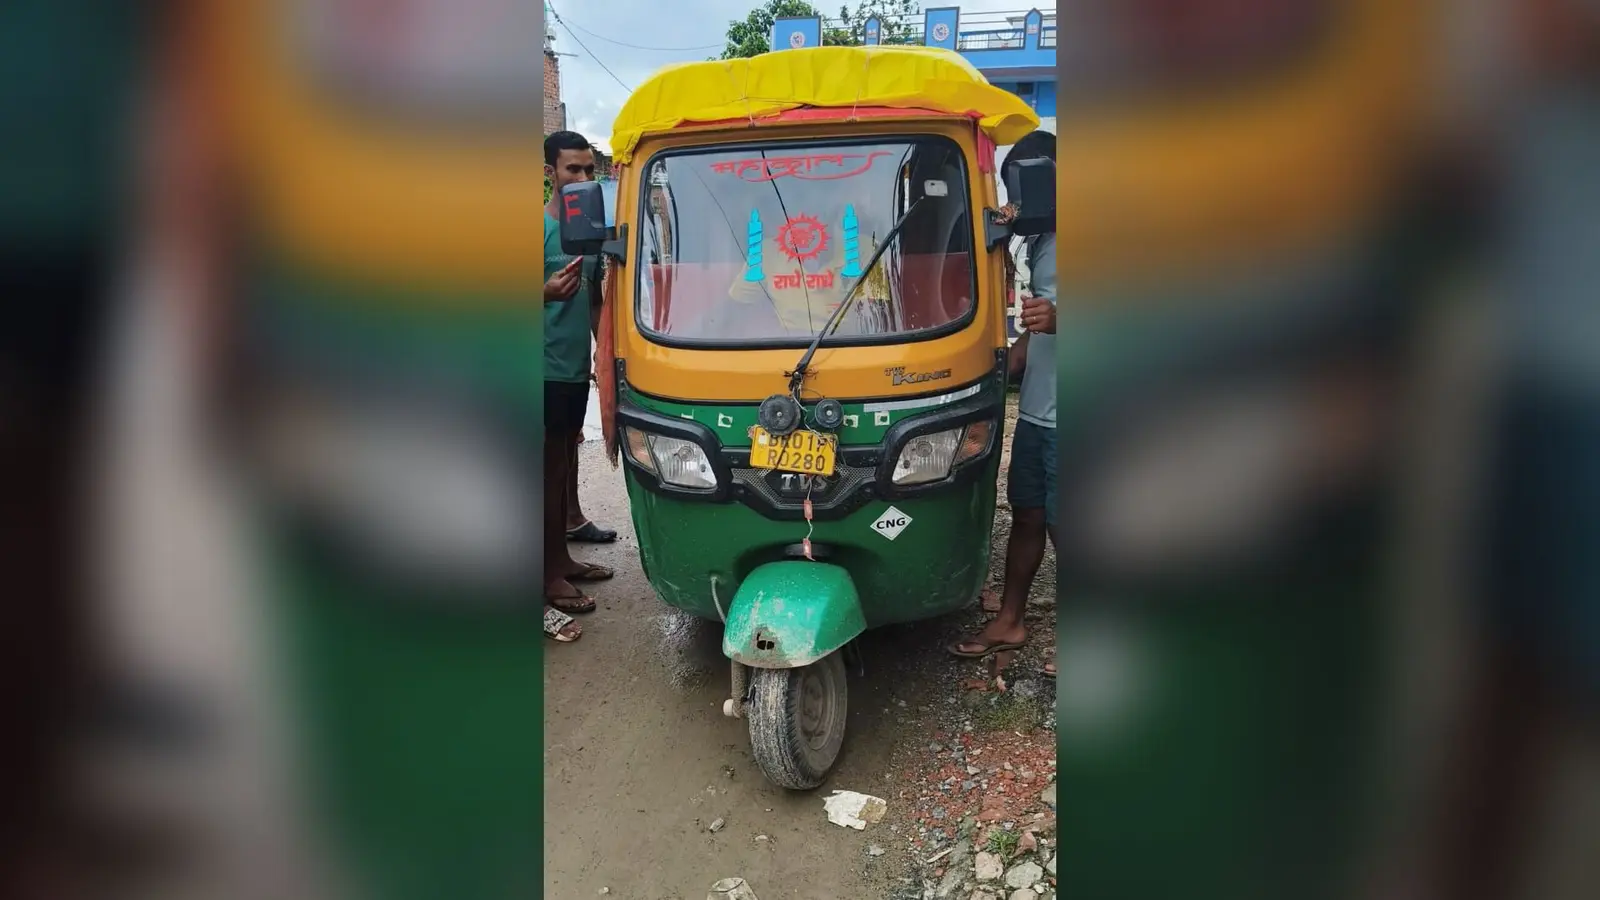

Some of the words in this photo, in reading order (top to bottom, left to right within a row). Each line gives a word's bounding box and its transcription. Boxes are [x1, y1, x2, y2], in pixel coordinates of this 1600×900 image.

[773, 268, 801, 290] राधे
[805, 267, 834, 289] राधे
[780, 473, 827, 491] TVS
[876, 517, 906, 530] CNG
